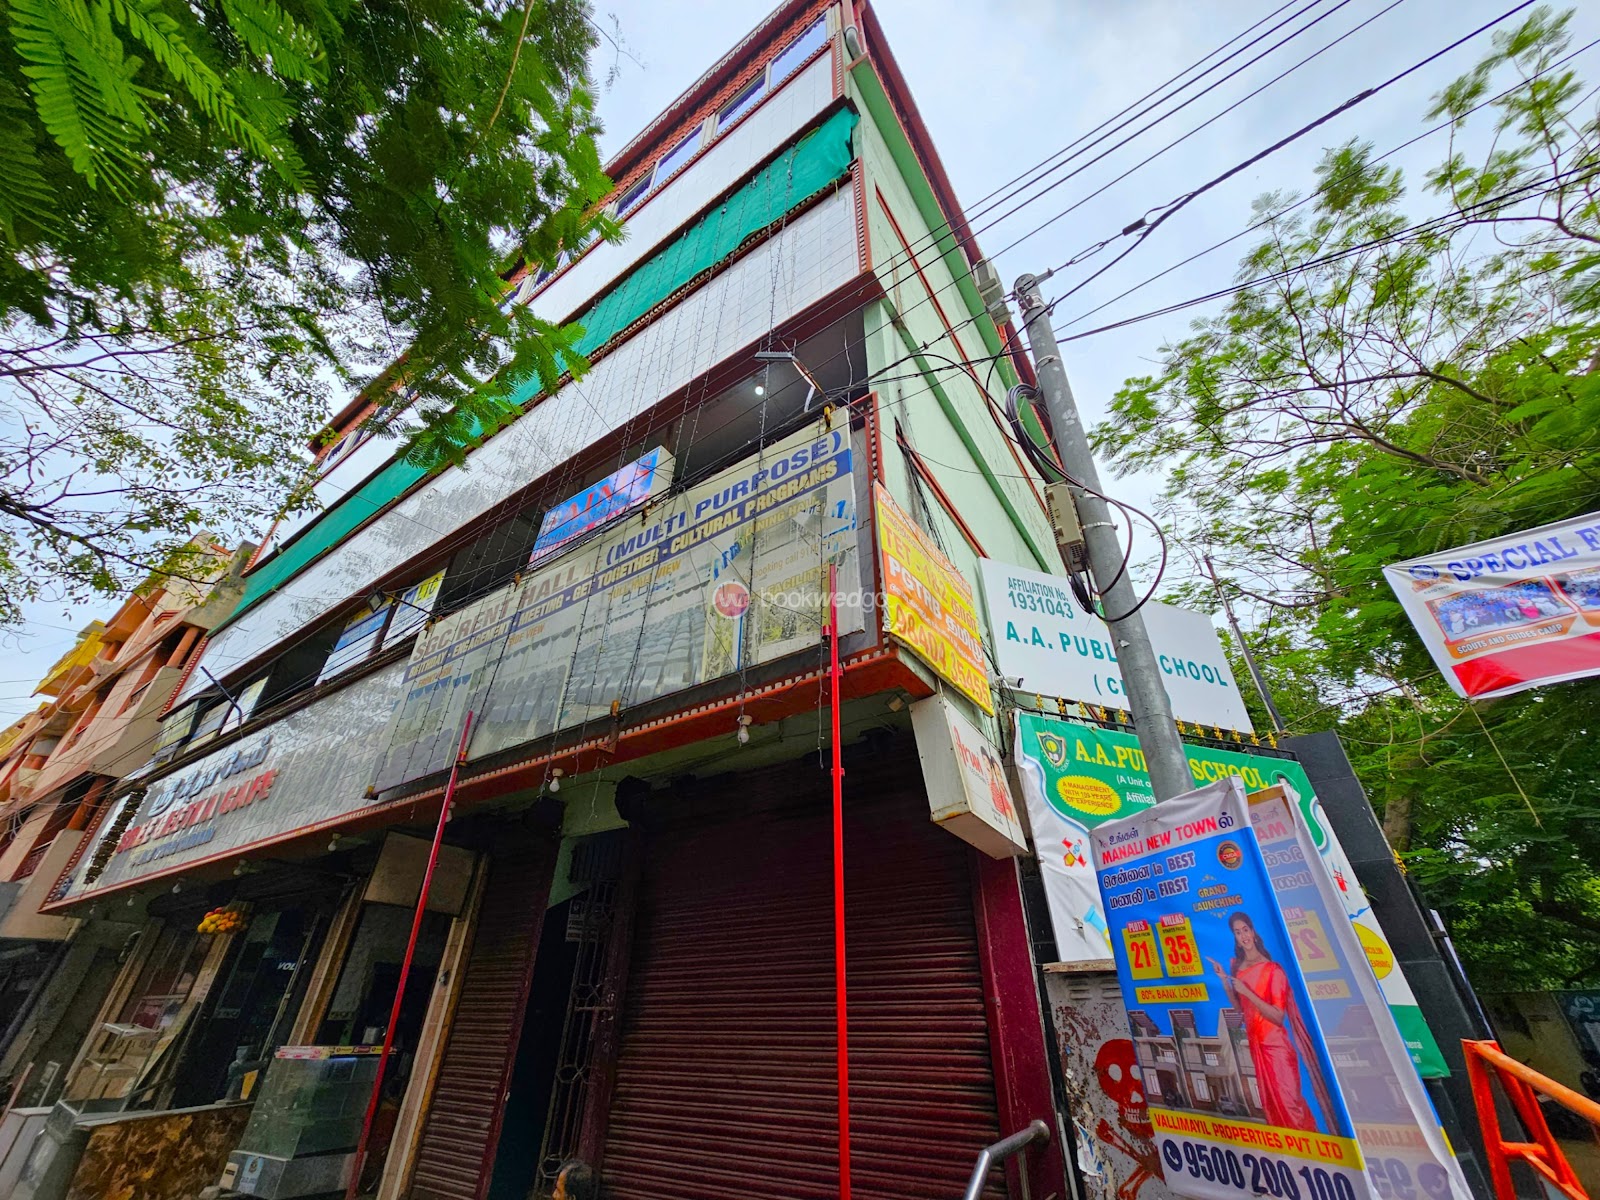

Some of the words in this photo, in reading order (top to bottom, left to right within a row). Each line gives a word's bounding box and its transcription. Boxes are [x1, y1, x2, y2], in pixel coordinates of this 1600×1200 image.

[413, 628, 453, 661] SGC
[456, 596, 515, 641] RENT
[520, 564, 581, 604] HALL
[606, 510, 687, 566] (MULTI
[694, 430, 842, 521] PURPOSE)
[518, 594, 564, 627] MEETING
[572, 581, 593, 602] GET
[597, 546, 660, 588] TOGETHER
[671, 507, 741, 554] CULTURAL
[744, 458, 838, 518] PROGRAMS
[882, 522, 911, 567] TET
[1447, 536, 1579, 582] SPECIAL
[1008, 577, 1054, 599] AFFILIATION
[1055, 586, 1069, 602] No.
[1008, 590, 1074, 619] 1931043
[1457, 640, 1488, 654] SCOUTS
[1489, 636, 1505, 646] AND
[1506, 629, 1537, 642] GUIDES
[1538, 623, 1563, 635] CAMP
[1006, 621, 1053, 650] A.A.
[1059, 632, 1118, 663] PUBL
[1160, 655, 1228, 687] CHOOL
[1128, 775, 1145, 788] Unit
[1188, 758, 1270, 788] SCHOOL
[219, 768, 280, 815] CAFE
[1102, 841, 1144, 865] MANALI
[1146, 831, 1171, 850] NEW
[1153, 863, 1163, 876] la
[1167, 851, 1195, 872] BEST
[1147, 888, 1156, 900] la
[1158, 877, 1189, 898] FIRST
[1198, 884, 1228, 898] GRAND
[1192, 895, 1243, 912] LAUNCHING
[1128, 920, 1145, 932] PLOTS
[1163, 913, 1185, 926] VILLAS
[1130, 940, 1152, 969] 21
[1164, 934, 1193, 966] 35
[1181, 965, 1197, 973] BHK
[1140, 989, 1156, 1000] 80%
[1156, 989, 1178, 999] BANK
[1180, 987, 1203, 998] LOAN
[1153, 1112, 1212, 1138] VALLIMAYIL
[1213, 1124, 1283, 1149] PROPERTIES
[1287, 1137, 1311, 1153] PVT
[1317, 1141, 1344, 1160] LTD
[1182, 1140, 1247, 1190] 9500
[1243, 1152, 1301, 1200] 200
[1299, 1165, 1356, 1200] 100
